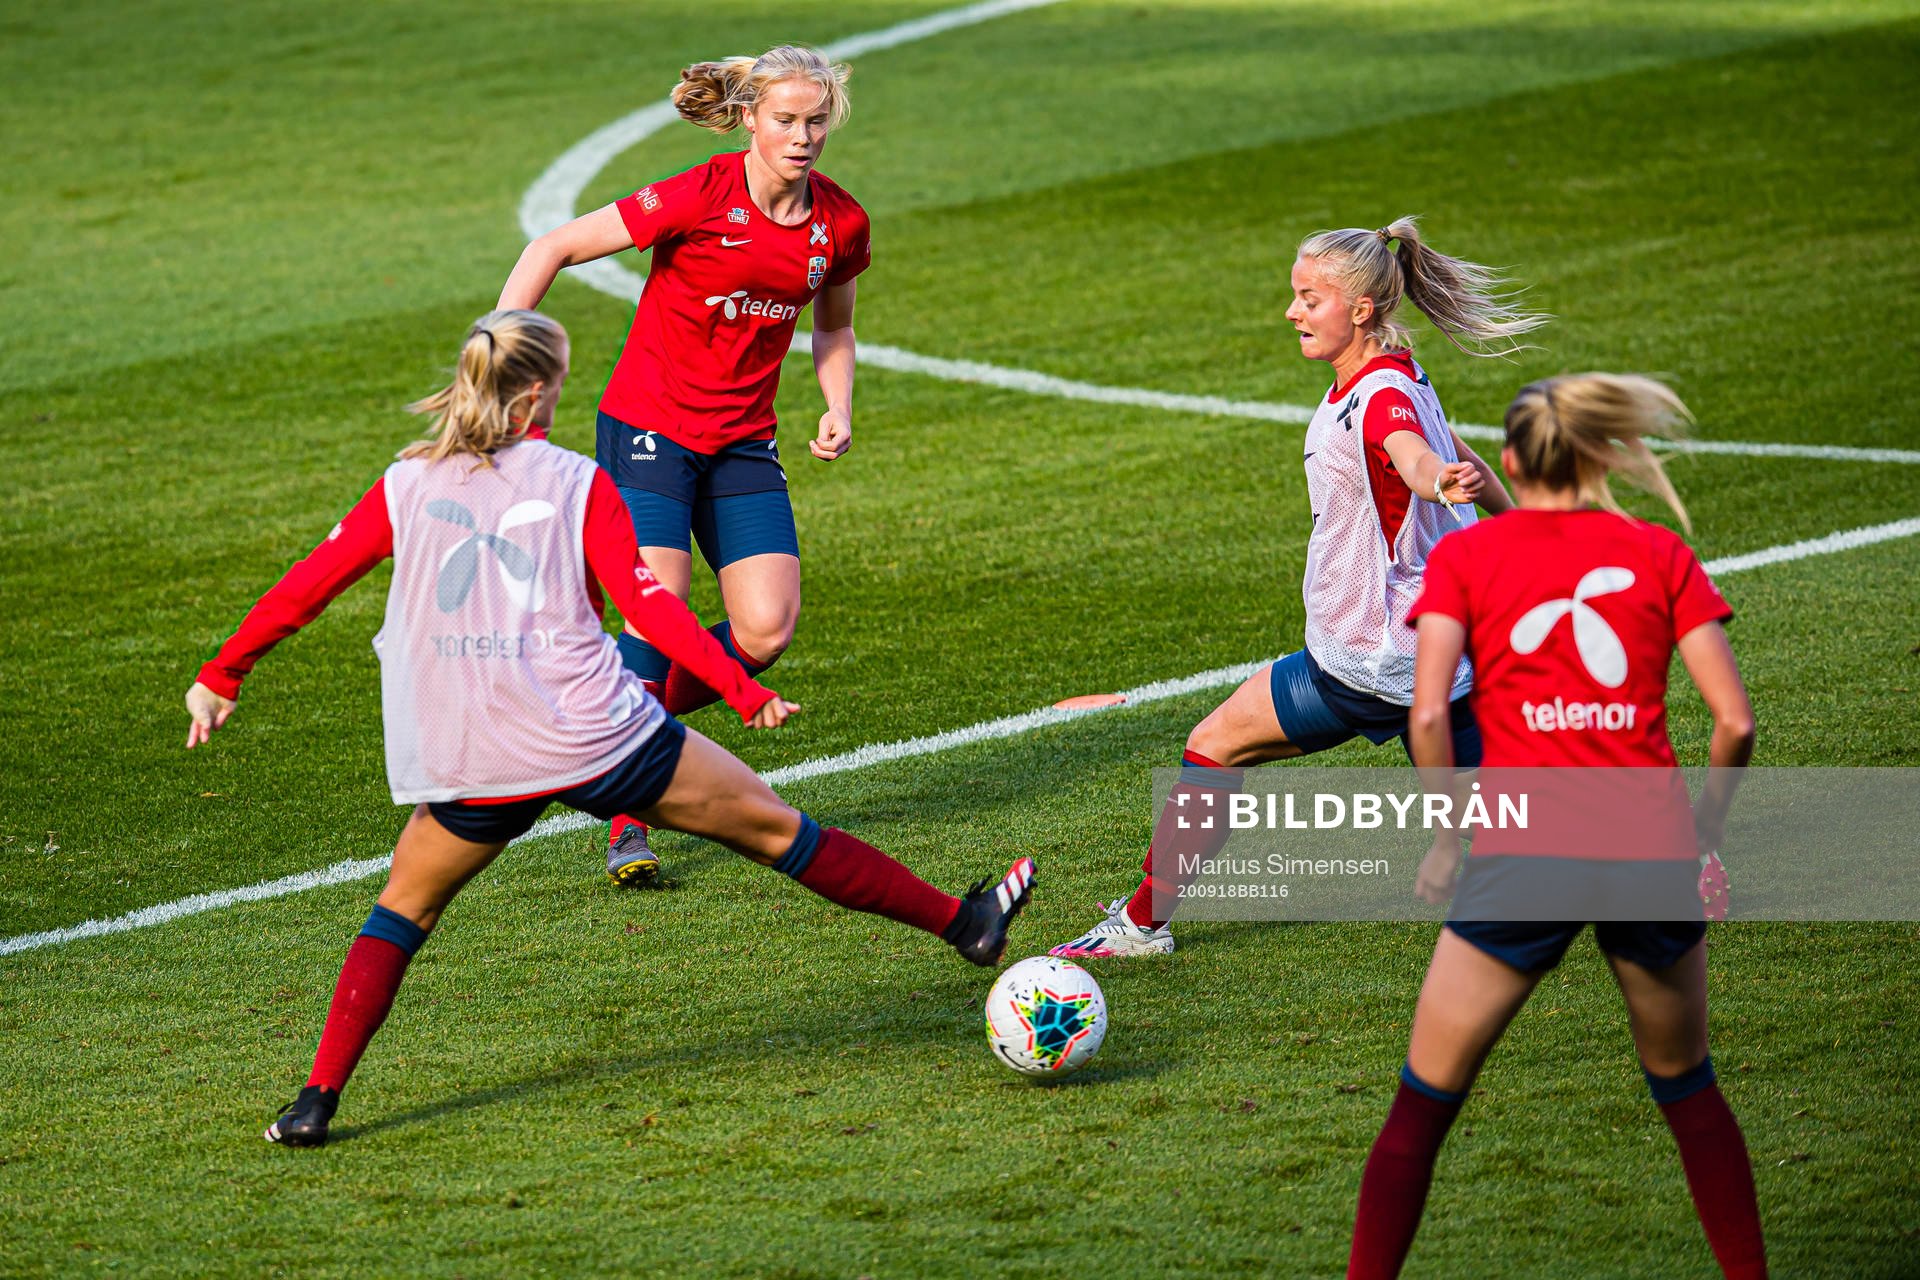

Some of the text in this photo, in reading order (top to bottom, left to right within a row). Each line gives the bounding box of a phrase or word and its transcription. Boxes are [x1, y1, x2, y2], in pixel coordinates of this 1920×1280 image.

[636, 187, 658, 210] DNB
[741, 297, 803, 320] telen
[631, 453, 657, 461] telenor
[1521, 696, 1637, 732] telenor
